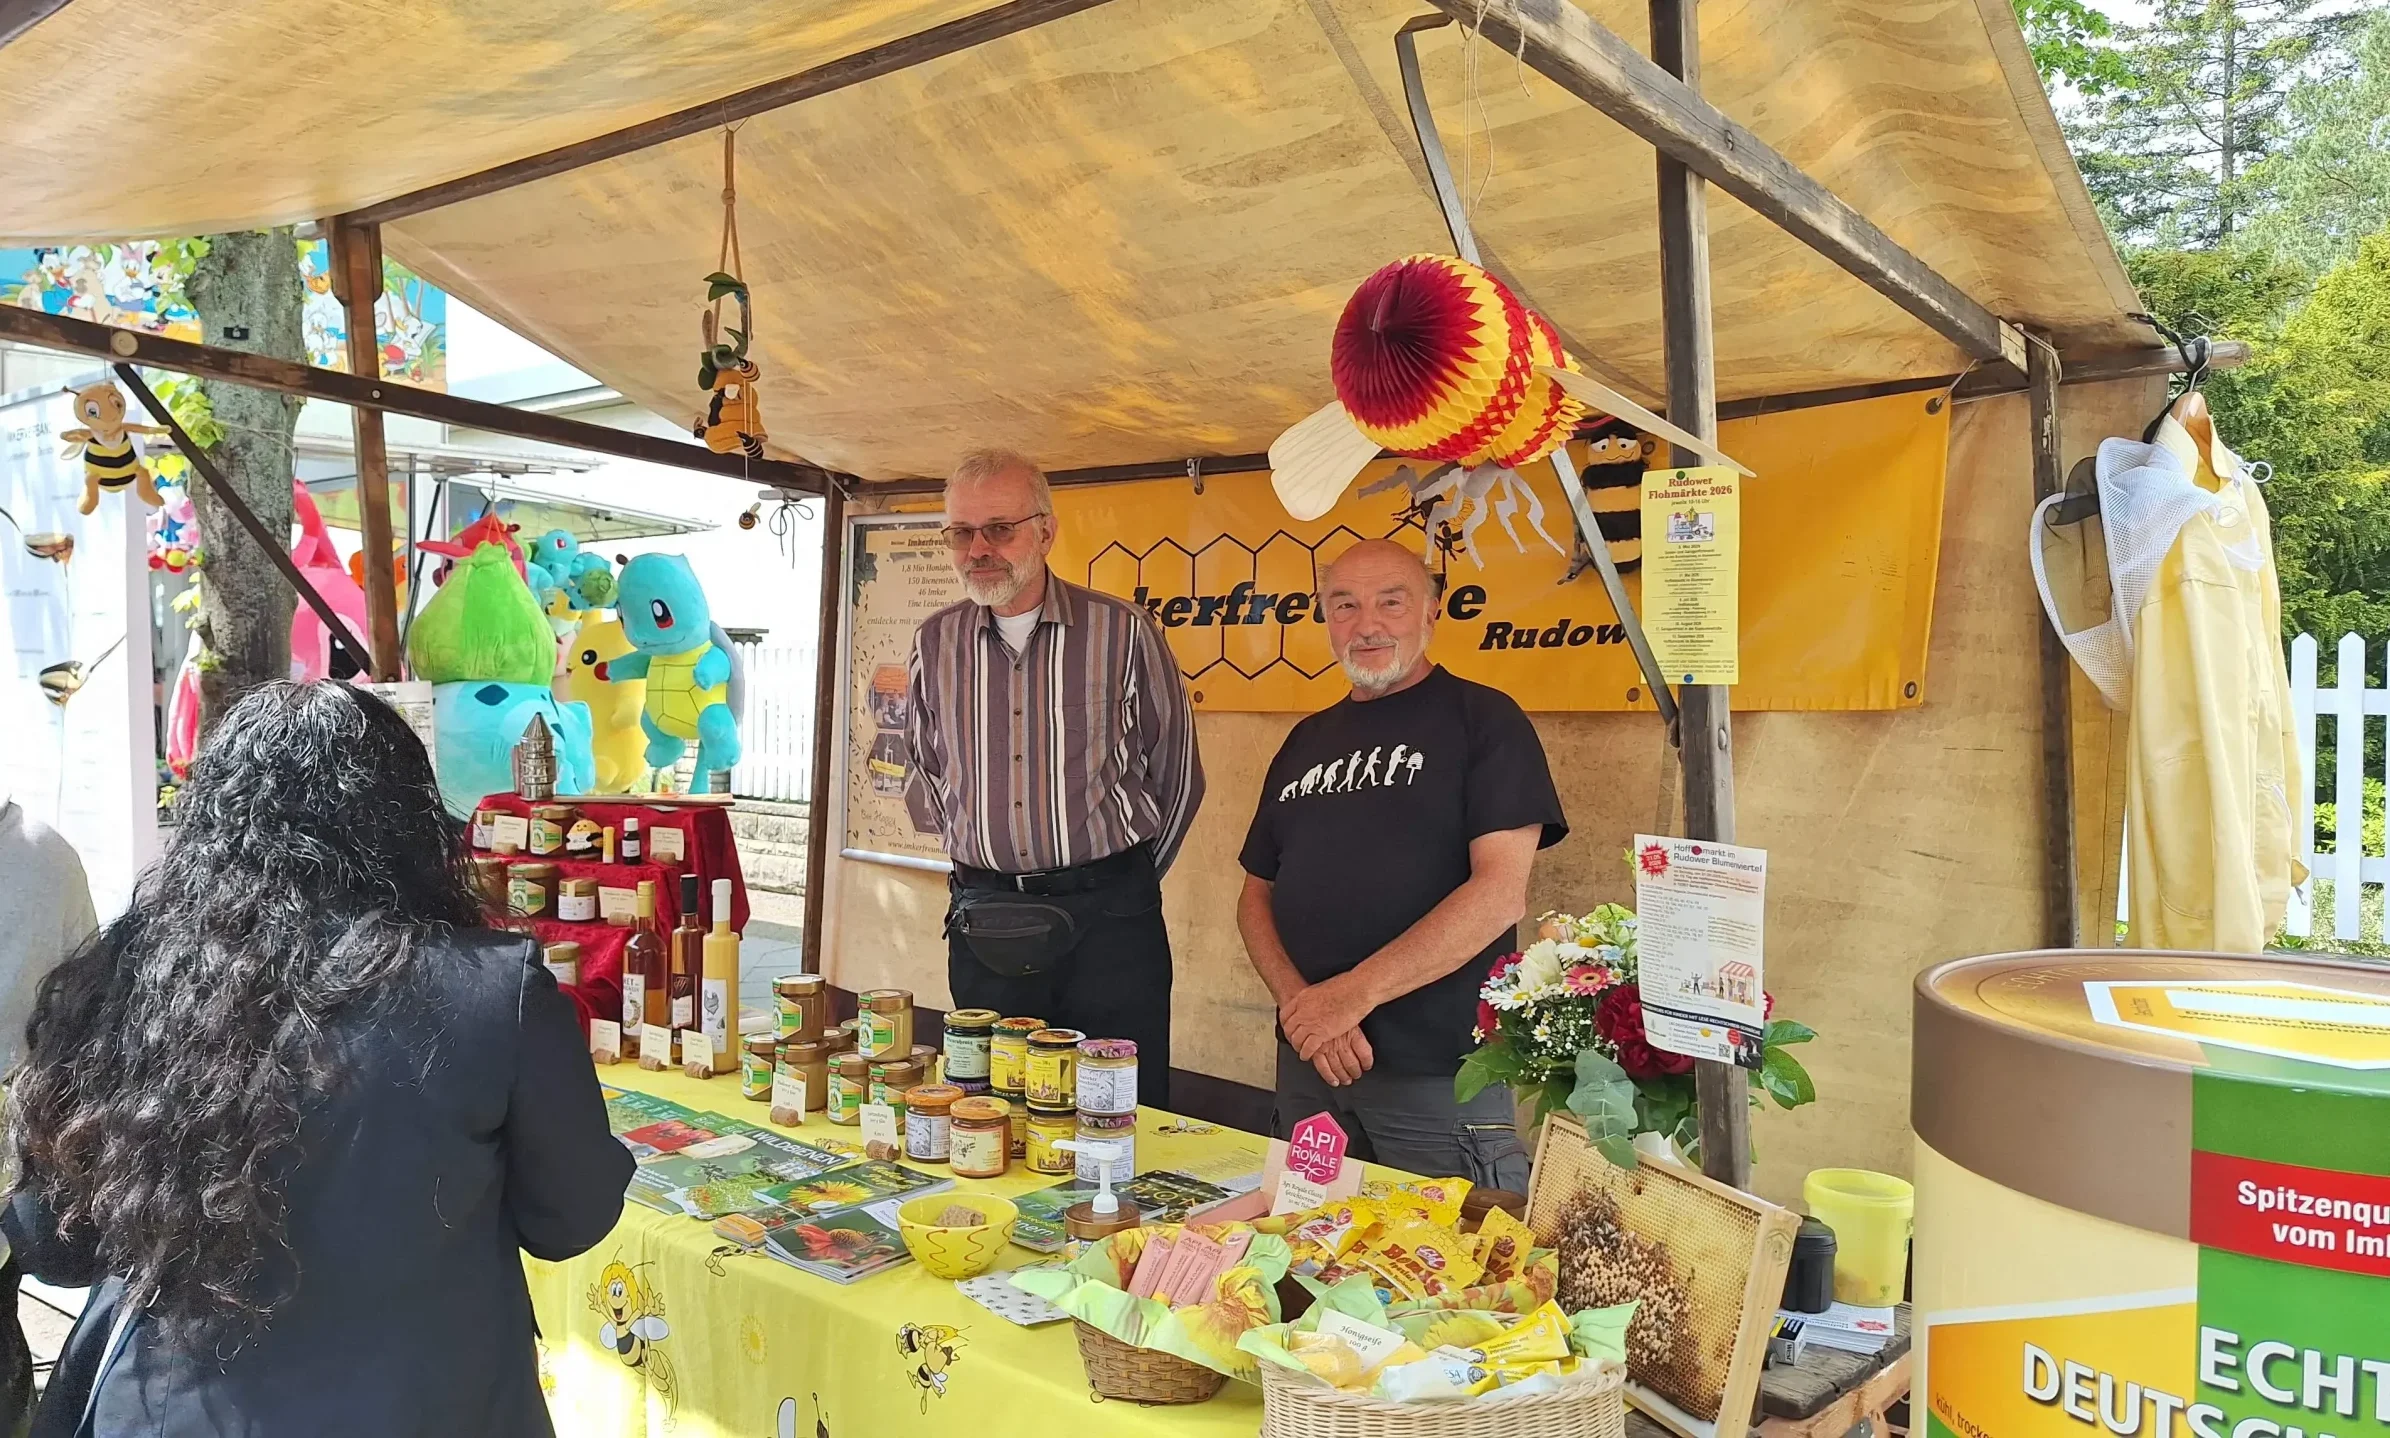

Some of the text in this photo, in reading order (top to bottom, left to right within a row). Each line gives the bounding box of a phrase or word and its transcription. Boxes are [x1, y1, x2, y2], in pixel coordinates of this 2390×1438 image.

[1668, 477, 1713, 487] Rudower
[1648, 485, 1733, 499] Flohmärkte 2026
[908, 537, 951, 547] Imkerfreun
[913, 564, 925, 572] Mio
[926, 564, 953, 573] Honigbi
[921, 577, 960, 585] Bienenstöck
[928, 588, 947, 596] Imker
[923, 600, 953, 608] Leidensch
[867, 616, 897, 625] entdecke
[1479, 618, 1627, 650] Rudow
[1674, 843, 1736, 859] Hoffmarkt im
[1673, 853, 1710, 864] Rudower
[1711, 857, 1762, 872] Blumenviertel
[2187, 986, 2295, 1000] Mindestens
[2185, 1010, 2290, 1023] Deutscher
[752, 1131, 842, 1165] WILDBIENEN
[1298, 1125, 1337, 1153] API
[1291, 1145, 1338, 1170] ROYALE
[1291, 1182, 1308, 1193] Royale
[1308, 1189, 1324, 1200] Classic
[2237, 1180, 2390, 1228] Spitzenqu
[2272, 1222, 2390, 1259] vom Im
[1339, 1325, 1383, 1347] Honigseife
[1349, 1340, 1368, 1353] 100 g
[1785, 1343, 1793, 1361] West
[2200, 1325, 2390, 1422] ECHT
[2023, 1341, 2337, 1438] DEUTS
[1936, 1392, 1954, 1425] kühl,
